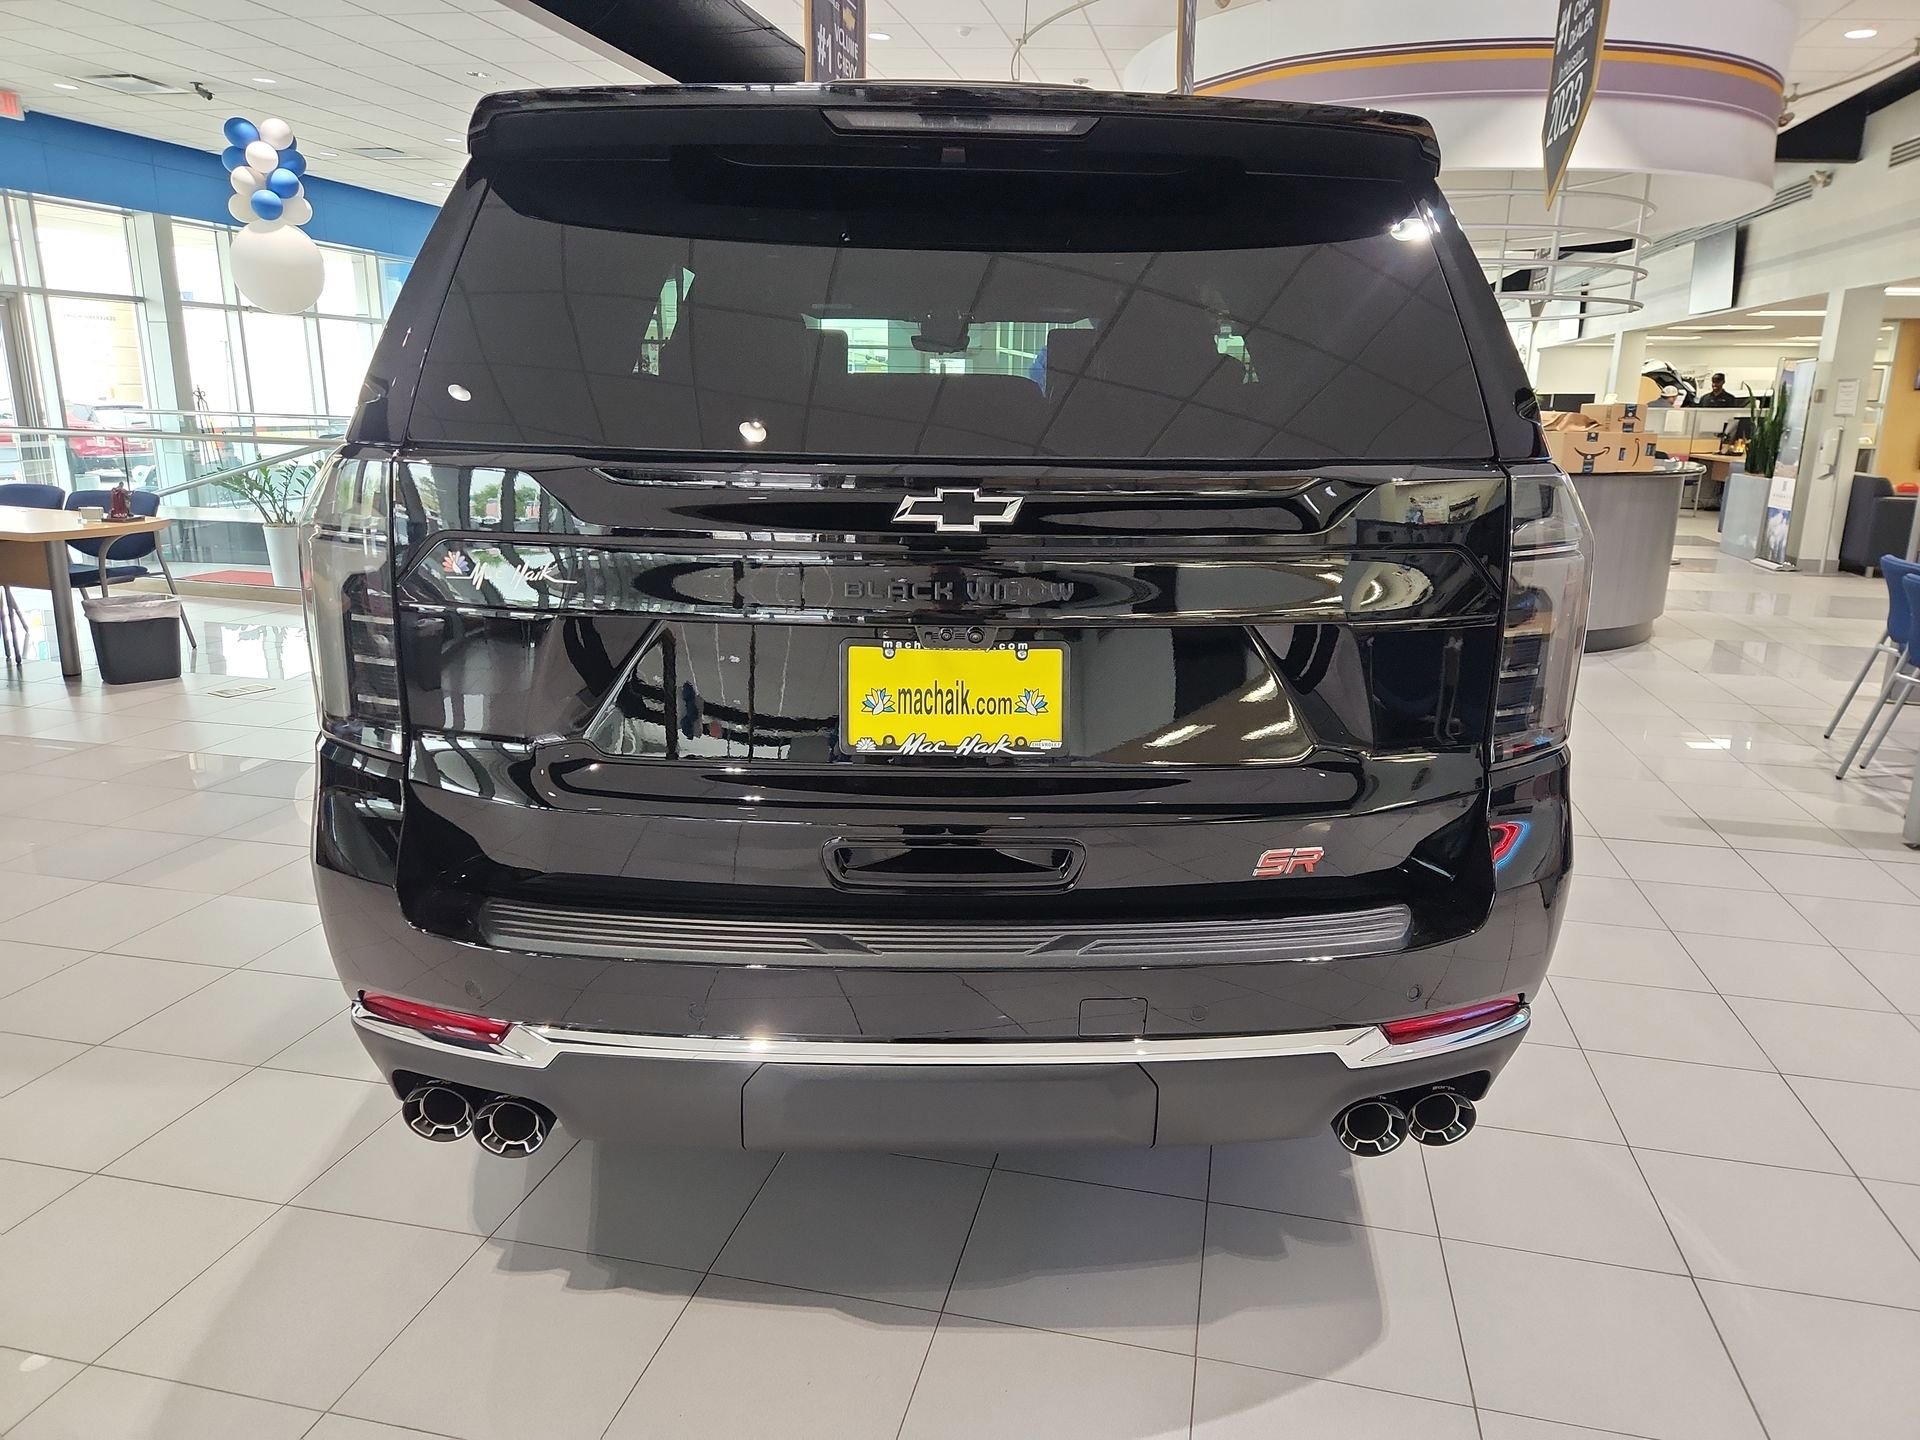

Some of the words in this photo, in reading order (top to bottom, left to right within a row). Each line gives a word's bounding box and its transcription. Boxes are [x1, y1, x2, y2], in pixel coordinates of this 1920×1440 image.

[833, 22, 859, 61] VOLUME
[1556, 1, 1572, 56] #1
[1568, 7, 1595, 51] DEALER
[817, 23, 832, 74] #1
[1545, 71, 1584, 149] 2023
[843, 578, 954, 601] BLACK
[966, 580, 1075, 602] WIDOW
[897, 680, 1013, 716] machaik.com
[898, 732, 955, 756] Mac
[953, 734, 1020, 756] Haik
[1252, 845, 1325, 877] SR
